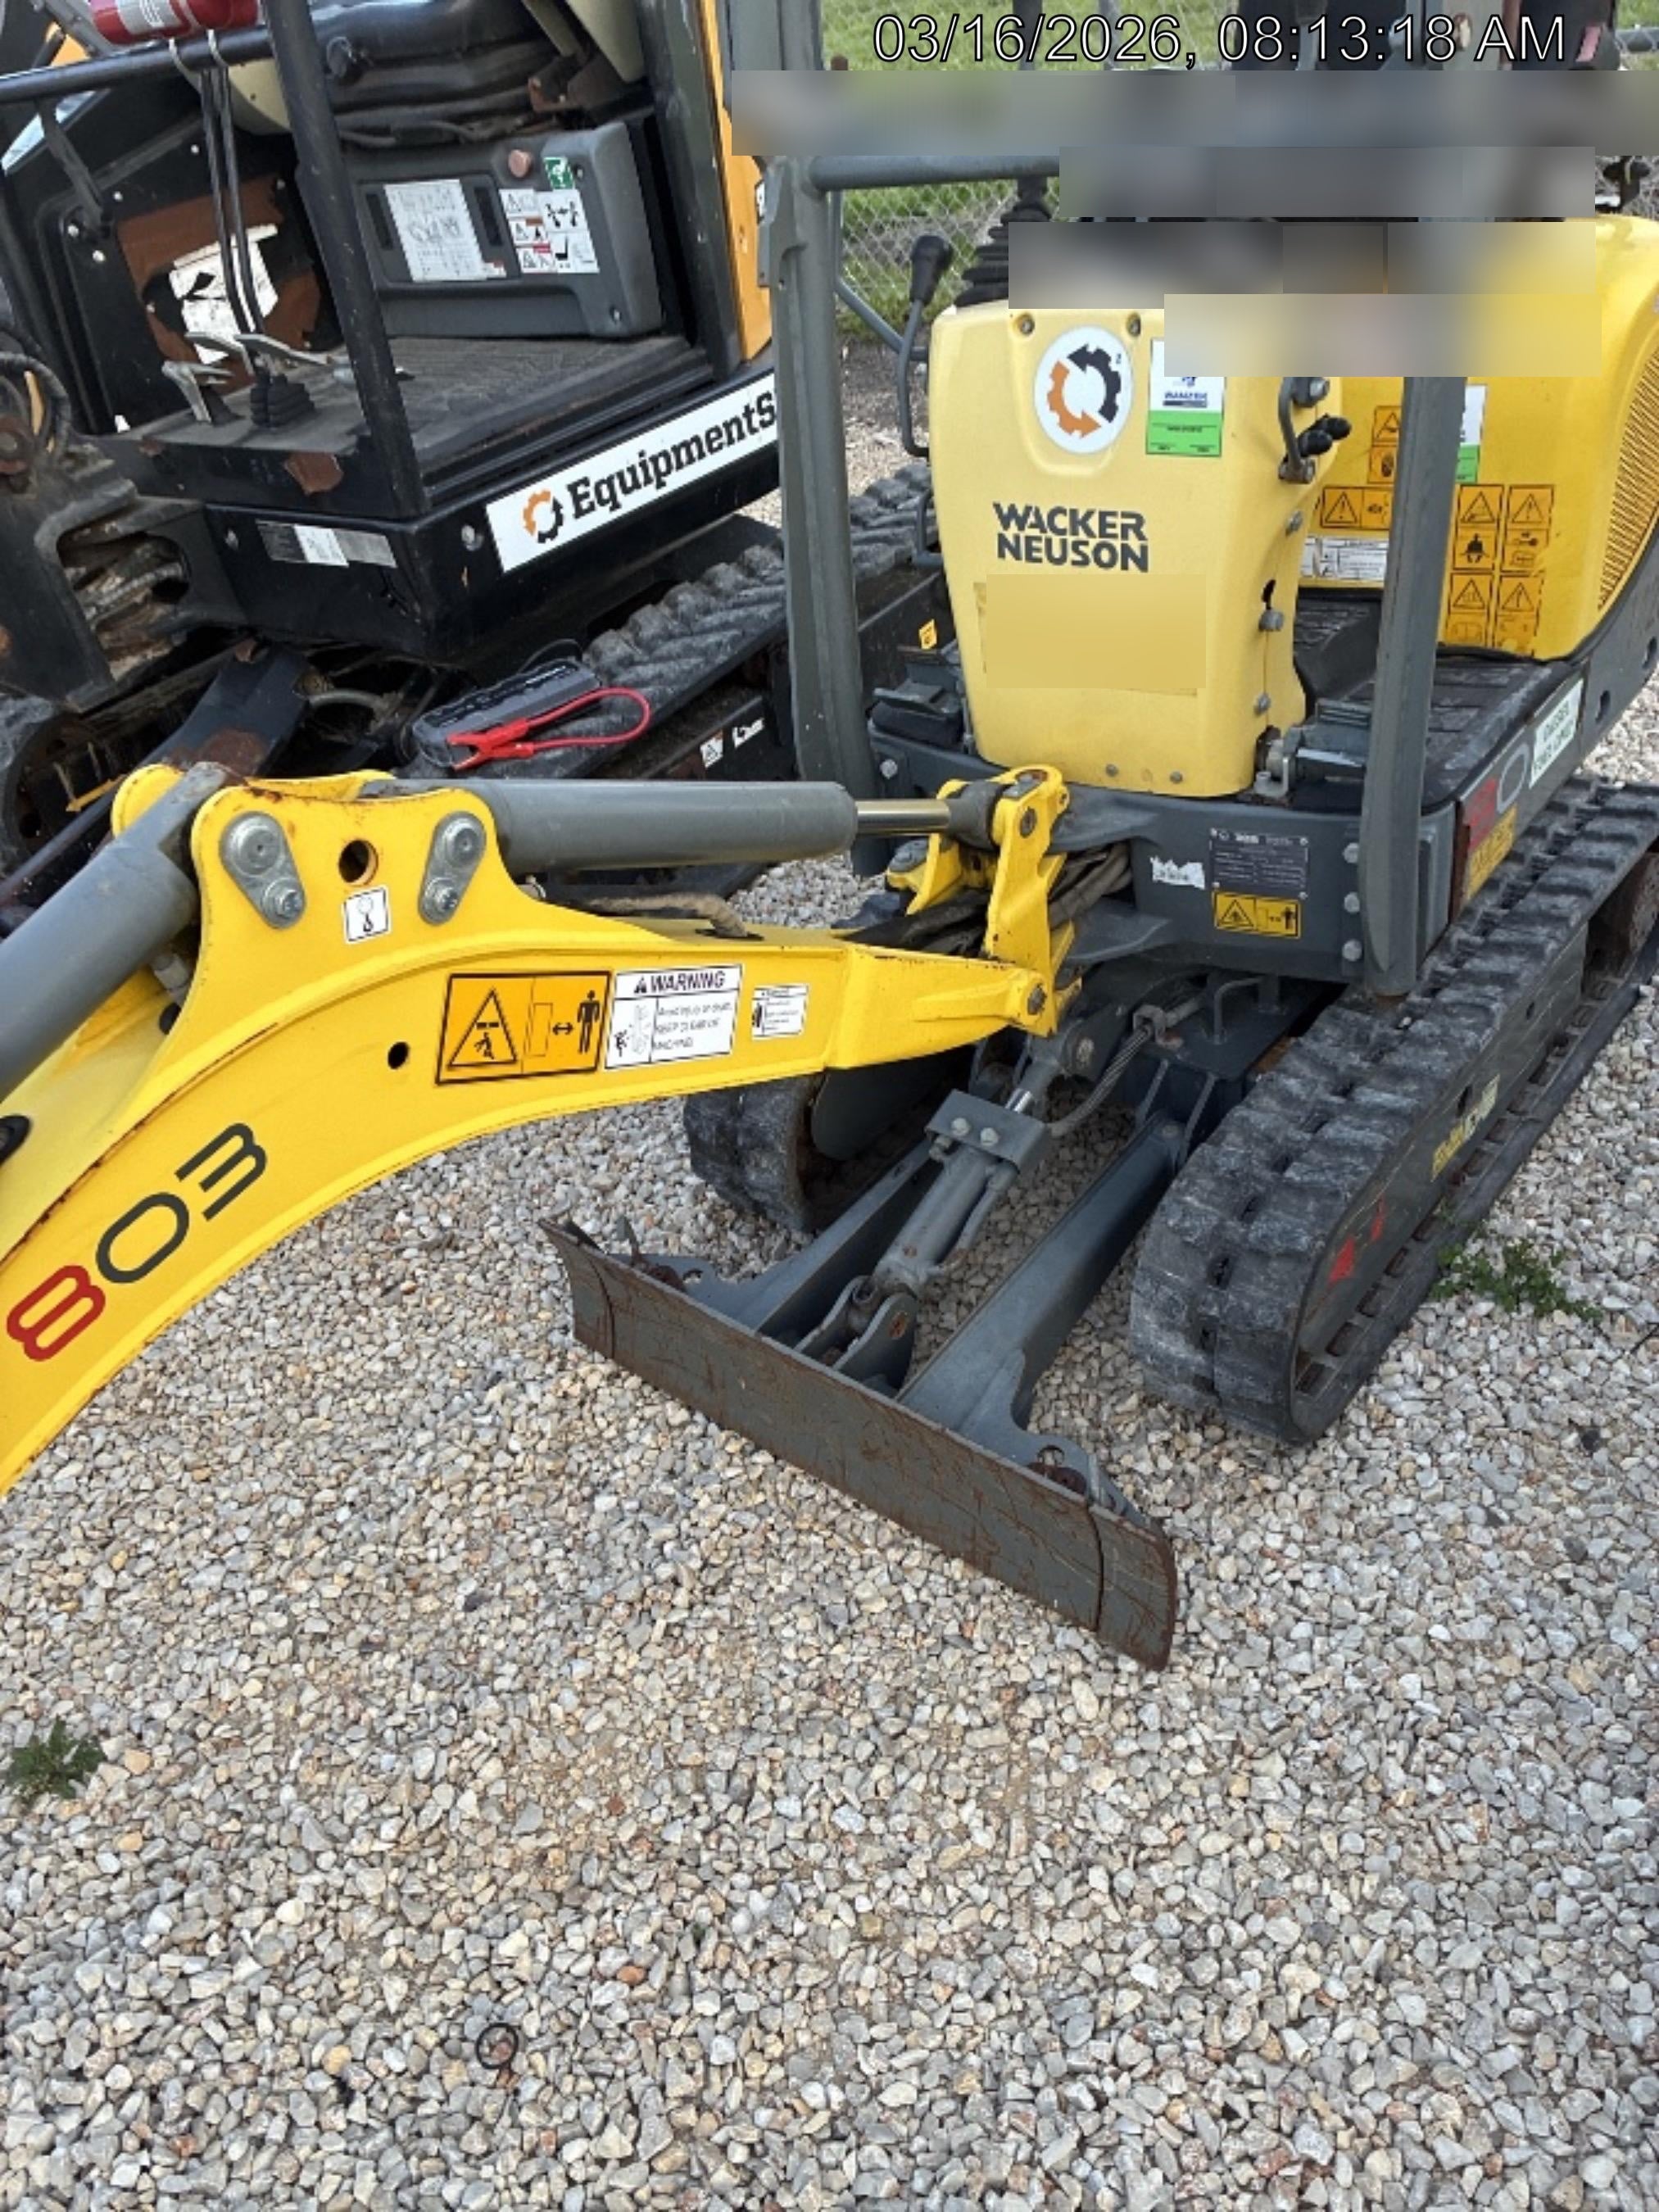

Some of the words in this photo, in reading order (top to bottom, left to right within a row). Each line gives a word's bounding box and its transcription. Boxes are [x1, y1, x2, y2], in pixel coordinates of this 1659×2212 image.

[992, 501, 1148, 542] WACKER
[997, 533, 1149, 573] NEUSON
[650, 970, 725, 994] WARNING
[7, 1122, 267, 1362] 803
